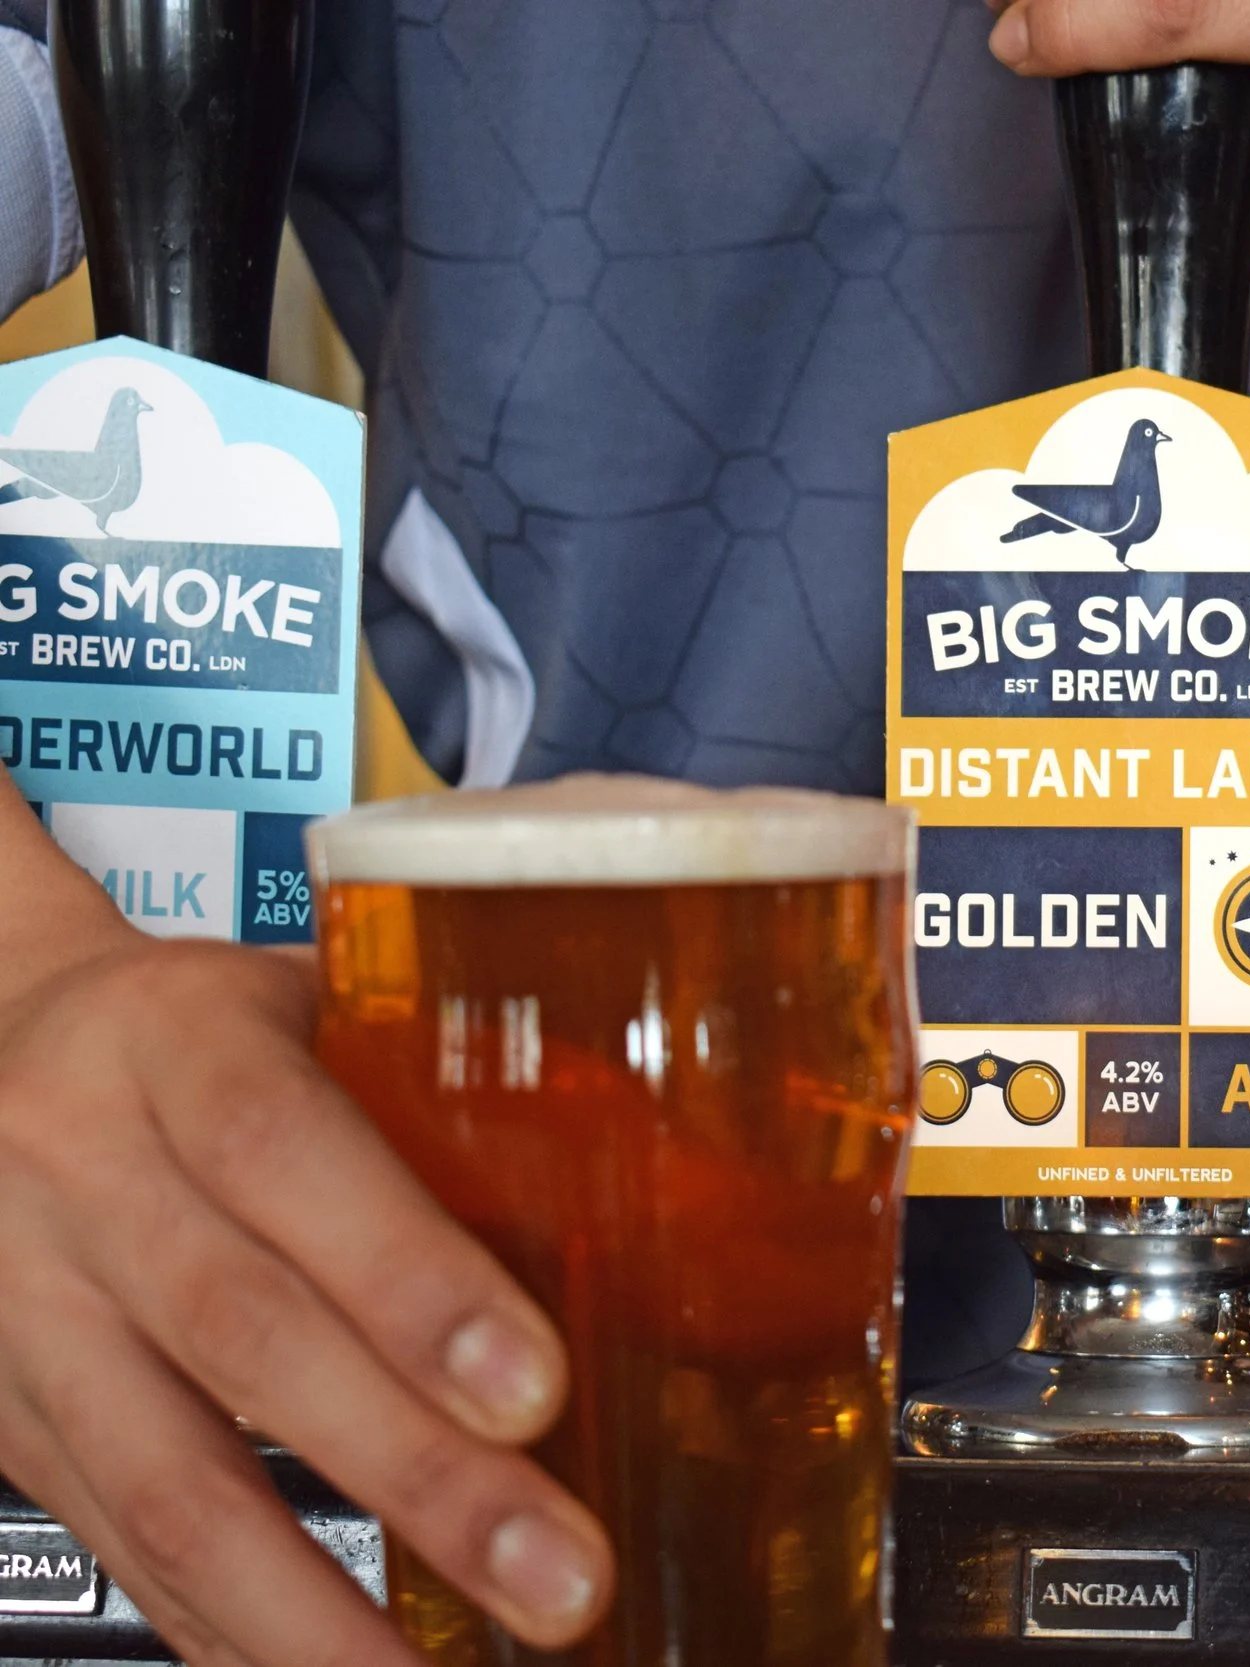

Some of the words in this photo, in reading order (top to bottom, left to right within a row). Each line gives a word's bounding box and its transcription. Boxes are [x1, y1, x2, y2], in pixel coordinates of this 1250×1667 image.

[58, 562, 320, 647] SMOKE
[927, 600, 1056, 671] BIG
[32, 633, 135, 668] BREW
[145, 638, 200, 671] CO.
[209, 655, 246, 671] LDN
[1004, 679, 1039, 693] EST
[1052, 670, 1159, 702] BREW
[1170, 670, 1227, 702] CO.
[901, 747, 1150, 798] DISTANT
[257, 869, 310, 901] 5%
[254, 903, 311, 926] ABV
[914, 893, 1167, 948] GOLDEN
[1100, 1061, 1164, 1084] 4.2%
[1101, 1092, 1159, 1113] ABV
[1037, 1167, 1110, 1182] UNFINED
[1115, 1168, 1127, 1182] &
[1132, 1168, 1233, 1183] UNFILTERED
[1040, 1582, 1180, 1606] ANGRAM
